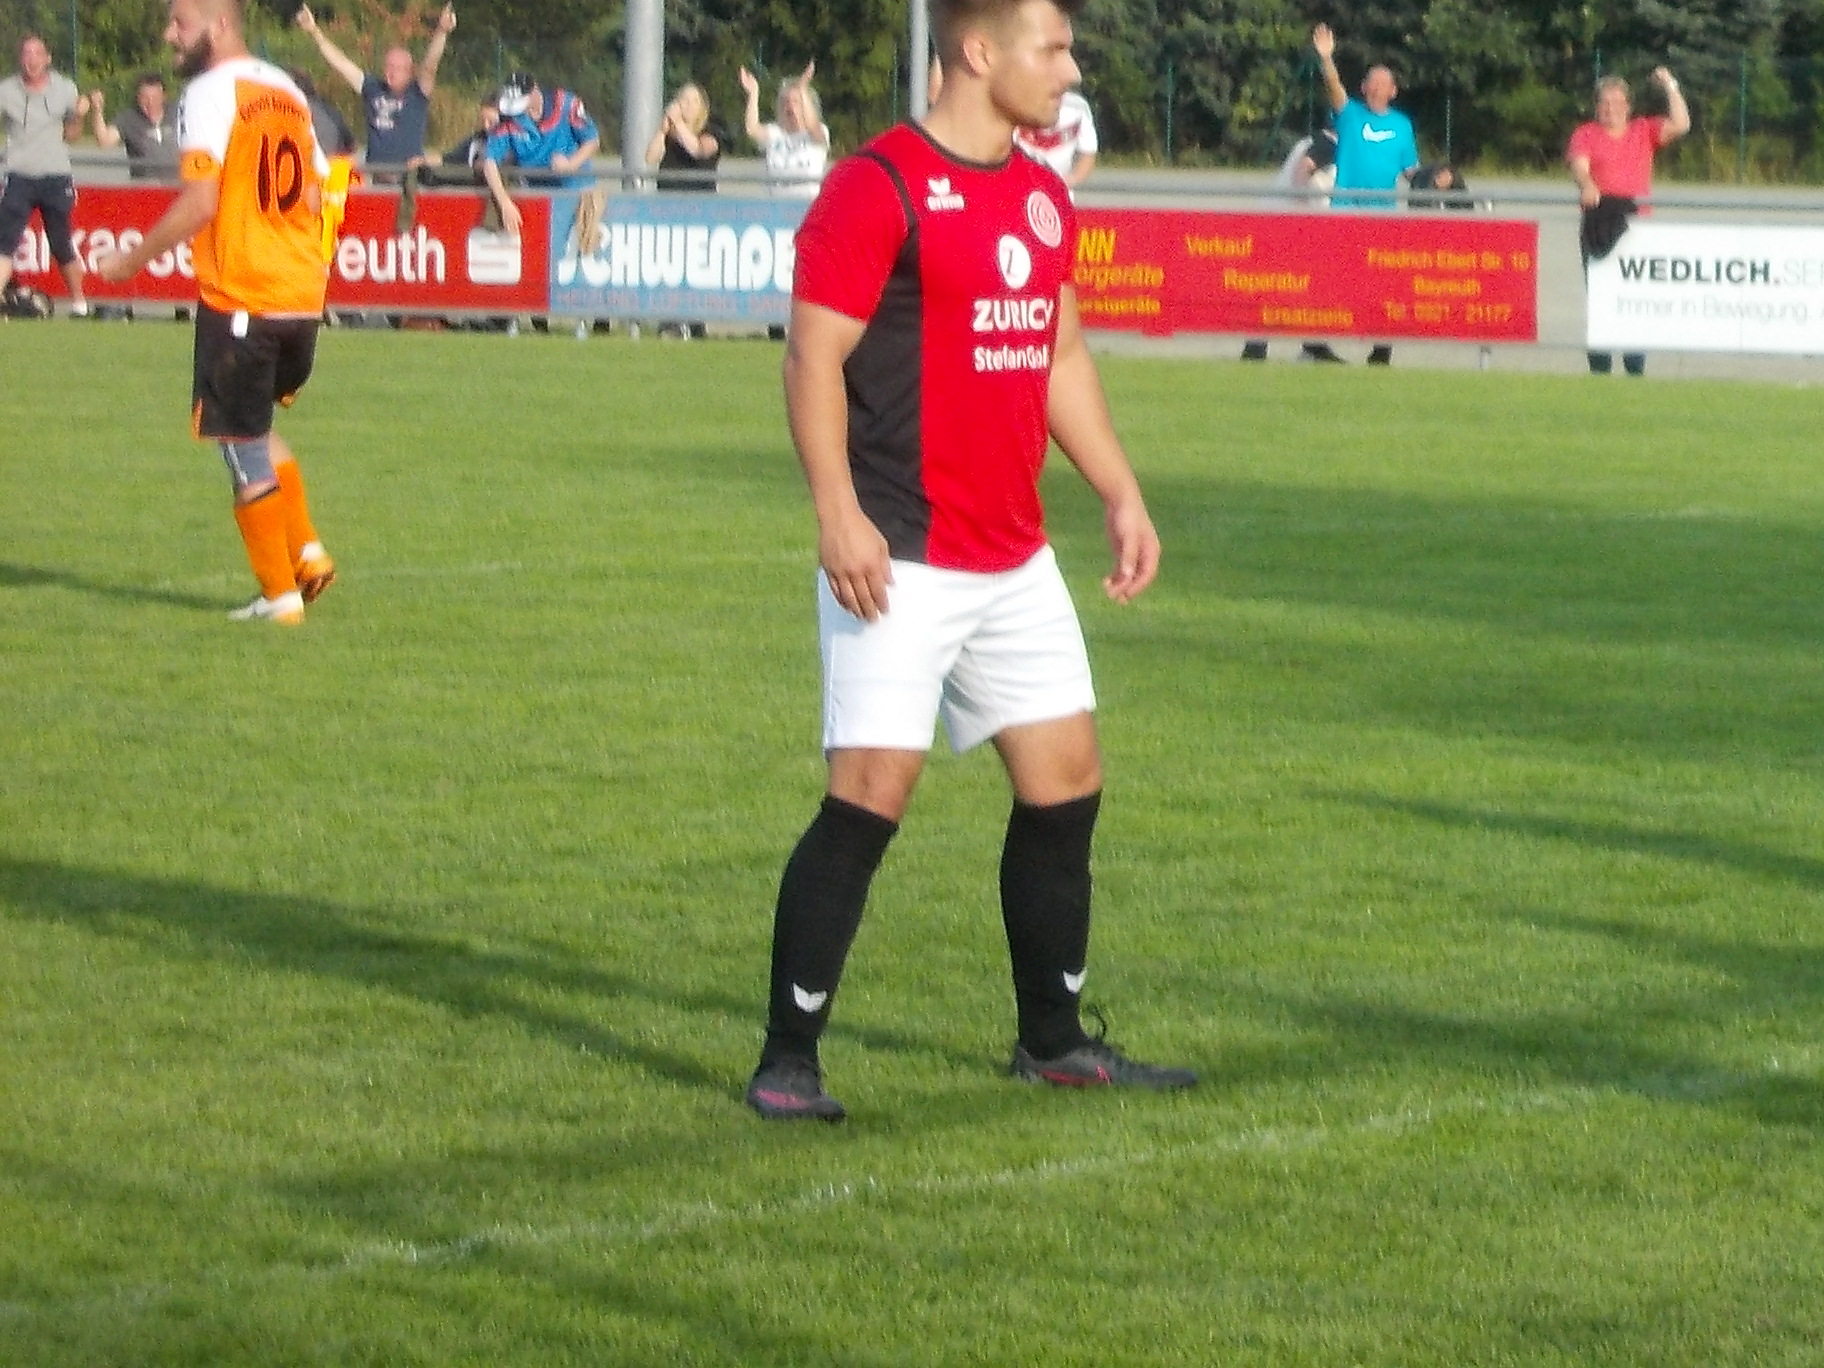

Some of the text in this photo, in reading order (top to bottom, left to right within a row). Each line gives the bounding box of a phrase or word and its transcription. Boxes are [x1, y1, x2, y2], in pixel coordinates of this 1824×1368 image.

[258, 133, 303, 213] 10
[336, 225, 446, 284] euth
[558, 222, 796, 293] SCHWENDE
[1077, 227, 1117, 262] NN
